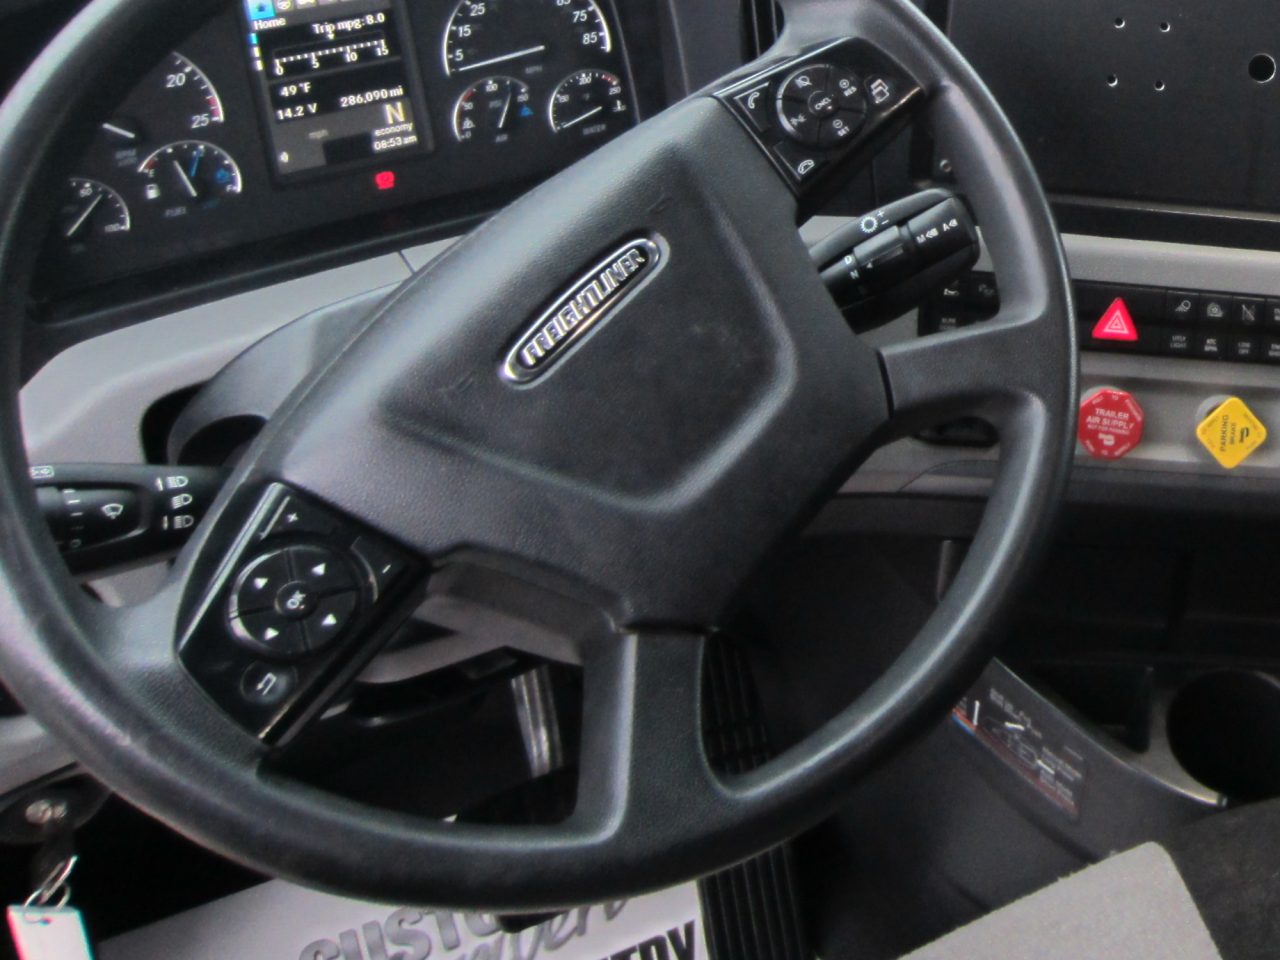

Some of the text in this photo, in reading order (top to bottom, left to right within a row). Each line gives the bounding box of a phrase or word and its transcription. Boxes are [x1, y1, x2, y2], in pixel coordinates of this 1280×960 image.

[470, 3, 486, 16] 25
[572, 10, 588, 22] 75
[253, 17, 286, 31] Home
[312, 12, 385, 36] Trip mpg: 8.0
[458, 25, 471, 37] 15
[582, 32, 598, 45] 85
[275, 46, 389, 76] 0 5 10 15
[455, 50, 464, 61] 5
[166, 73, 186, 88] 20
[579, 76, 592, 86] 200
[280, 85, 297, 97] 49
[389, 85, 403, 98] mi
[609, 86, 622, 95] 250
[277, 103, 318, 120] 14.2 V
[385, 101, 405, 124] N
[191, 114, 209, 128] 25
[374, 122, 413, 136] economy
[838, 126, 850, 136] SET
[373, 134, 418, 151] 08:53 am
[844, 254, 853, 265] D
[521, 248, 646, 366] FREIGHTLINER
[1095, 407, 1129, 420] TRAILER
[1086, 415, 1135, 430] AIR SUPPLY
[1220, 414, 1229, 452] PARKING
[286, 590, 306, 609] OK
